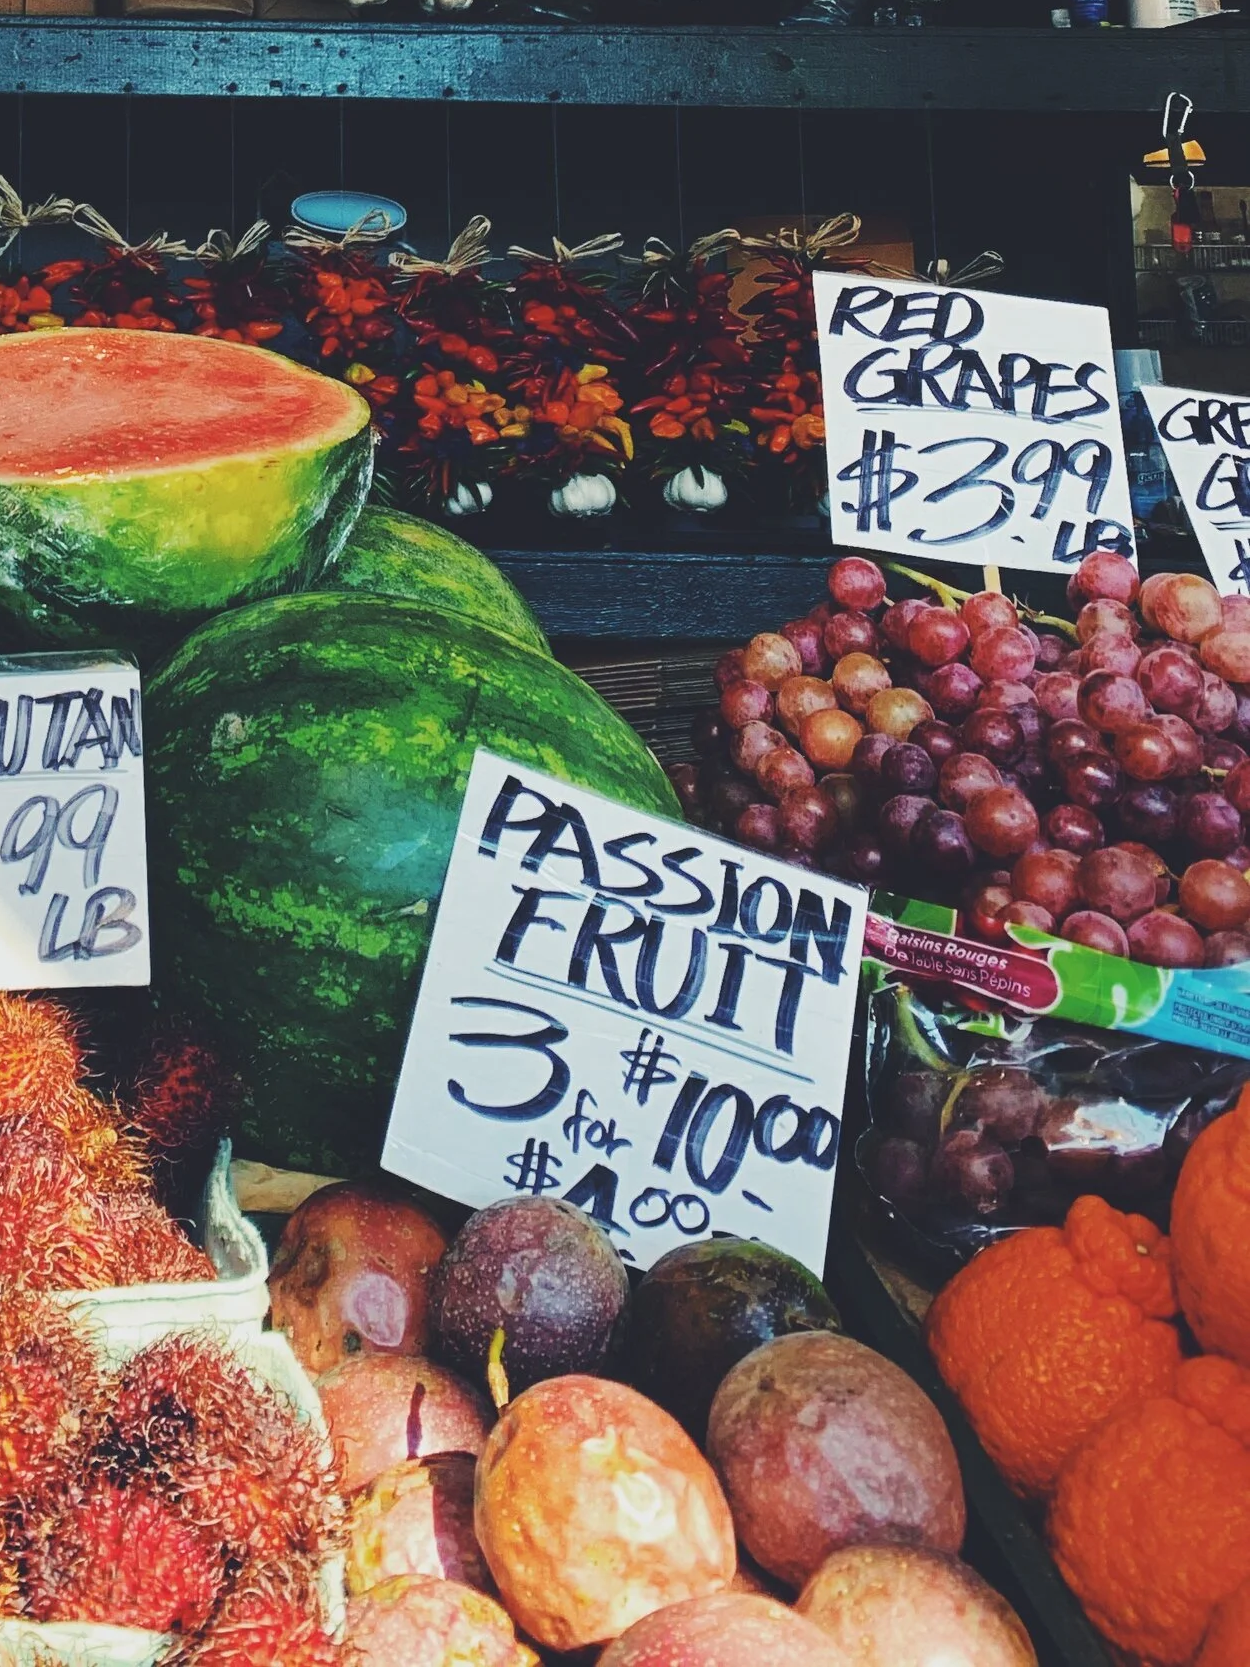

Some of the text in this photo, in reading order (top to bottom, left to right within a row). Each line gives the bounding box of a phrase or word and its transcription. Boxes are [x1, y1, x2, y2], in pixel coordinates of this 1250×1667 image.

[828, 285, 985, 344] RED
[843, 341, 1111, 423] GRAPES
[836, 429, 1134, 563] $3.99 LB
[478, 774, 851, 984] PASSION
[38, 886, 143, 963] LB
[943, 943, 1008, 970] Rouges
[492, 884, 822, 1055] FRUIT
[884, 945, 909, 961] De
[945, 962, 977, 983] Sans
[979, 968, 1031, 998] Pépins
[447, 997, 571, 1122] 3
[562, 1088, 632, 1157] for
